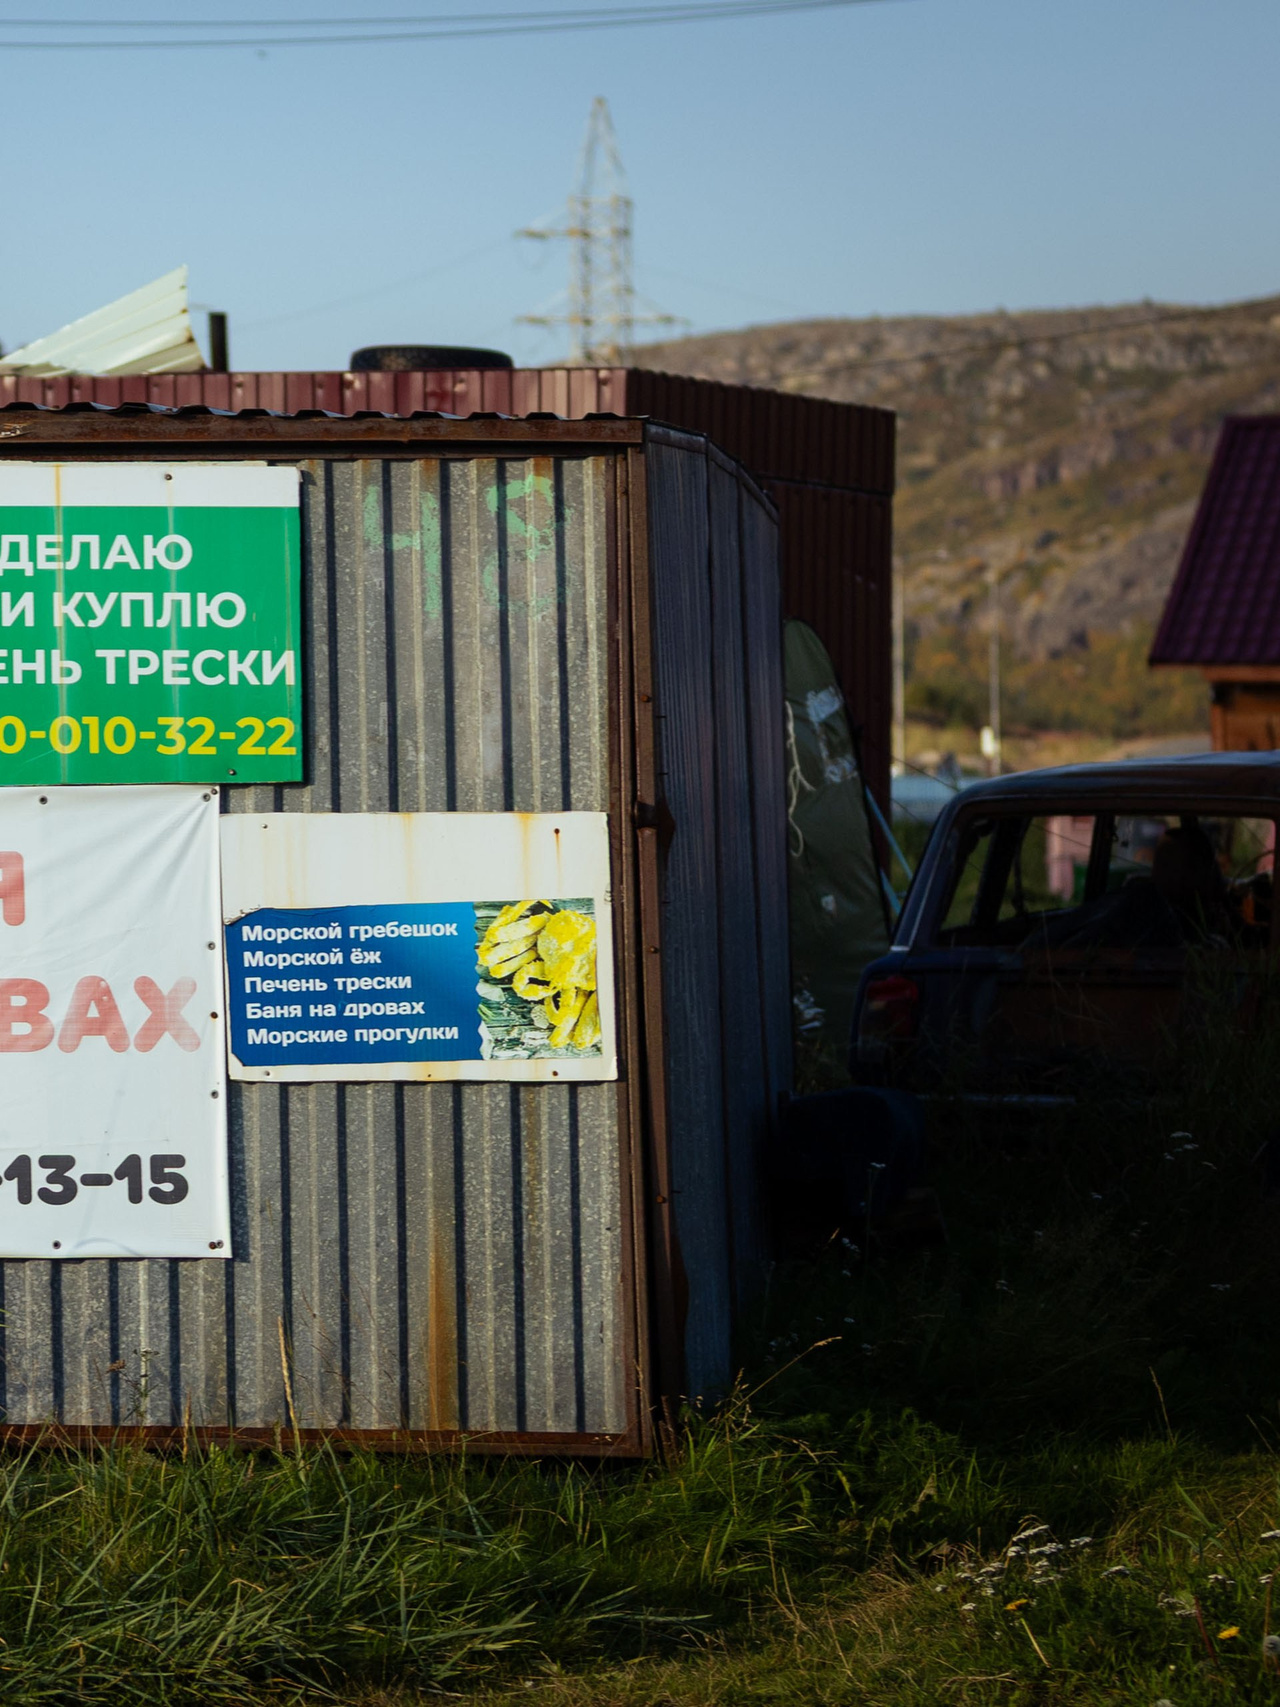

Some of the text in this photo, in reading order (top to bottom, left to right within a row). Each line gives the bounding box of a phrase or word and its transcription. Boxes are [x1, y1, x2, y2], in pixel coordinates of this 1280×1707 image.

[52, 591, 247, 628] КУПЛЮ
[95, 649, 296, 686] ТРЕСКИ
[241, 921, 459, 944] Морской гребешок
[243, 947, 382, 970] Морской ёж
[245, 975, 412, 994] Печень трески
[246, 1001, 426, 1019] Баня на дровах
[247, 1025, 459, 1047] Морские прогулки
